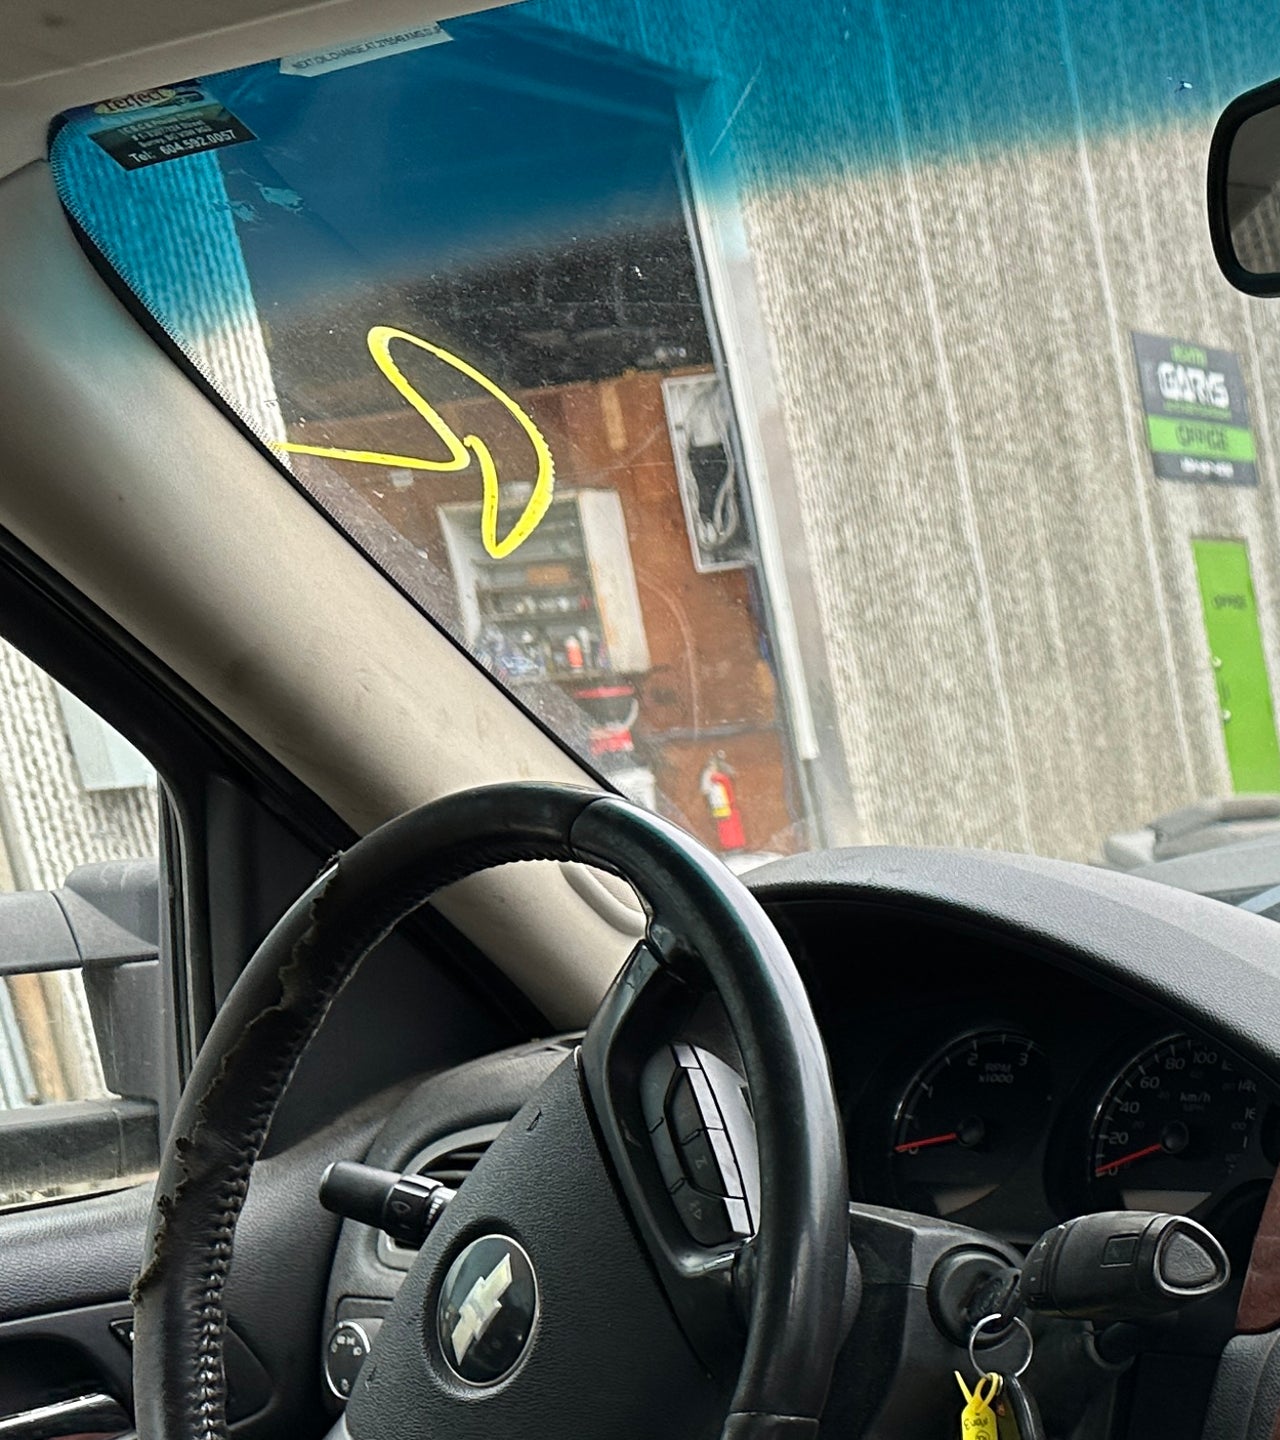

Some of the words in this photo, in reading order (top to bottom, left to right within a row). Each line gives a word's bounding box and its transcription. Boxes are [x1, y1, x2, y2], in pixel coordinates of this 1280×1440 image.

[128, 150, 158, 163] Tel:
[1164, 1057, 1186, 1070] 80
[1192, 1051, 1218, 1064] 100
[984, 1062, 1013, 1073] RPM
[1140, 1076, 1160, 1089] 60
[1179, 1091, 1212, 1104] km/h
[1119, 1101, 1141, 1115] 40
[1108, 1131, 1129, 1146] 20
